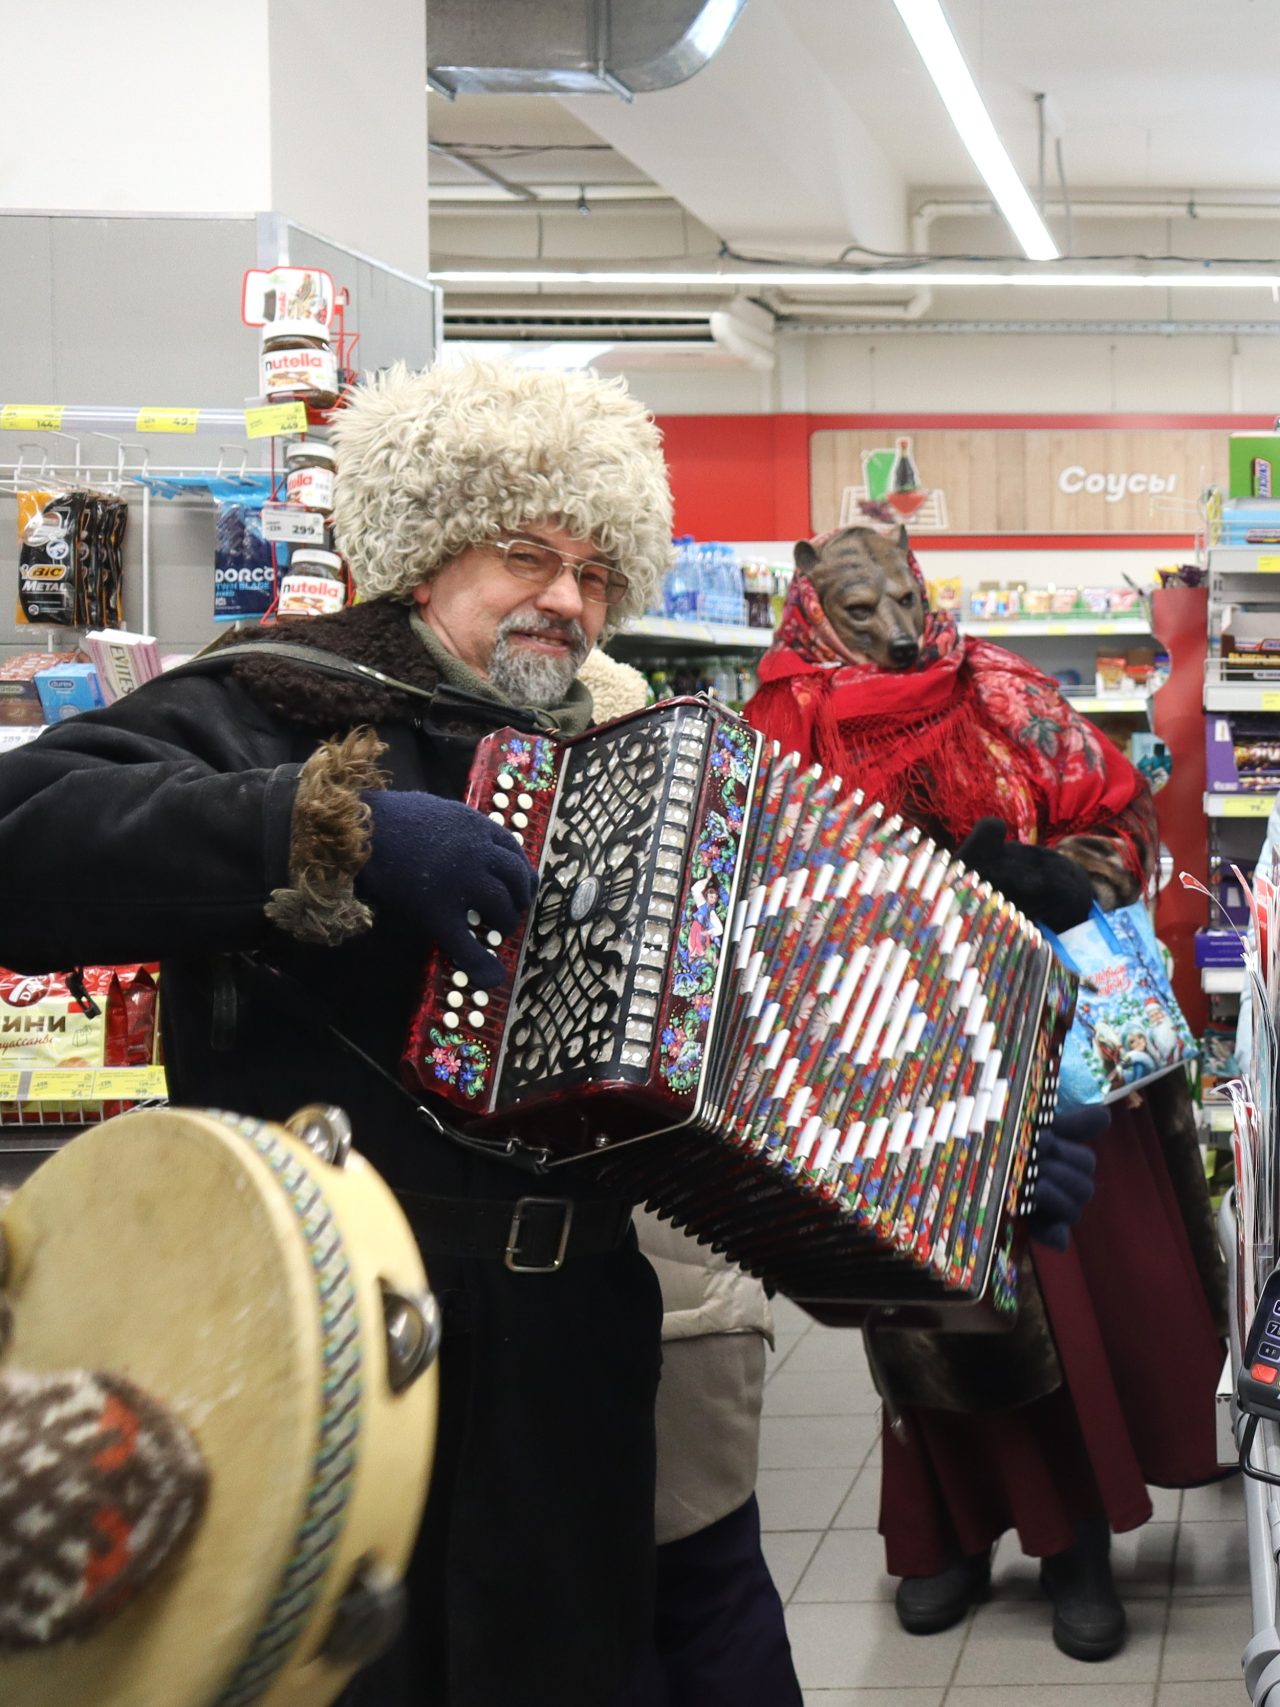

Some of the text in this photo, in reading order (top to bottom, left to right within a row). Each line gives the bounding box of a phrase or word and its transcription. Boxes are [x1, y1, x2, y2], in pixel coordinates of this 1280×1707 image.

[265, 353, 323, 371] nutella
[1058, 465, 1178, 502] Соусы
[292, 525, 315, 535] 299
[32, 567, 62, 577] BIC
[21, 580, 67, 592] METAL
[282, 582, 339, 598] nutella
[1, 1015, 66, 1033] ИНИ
